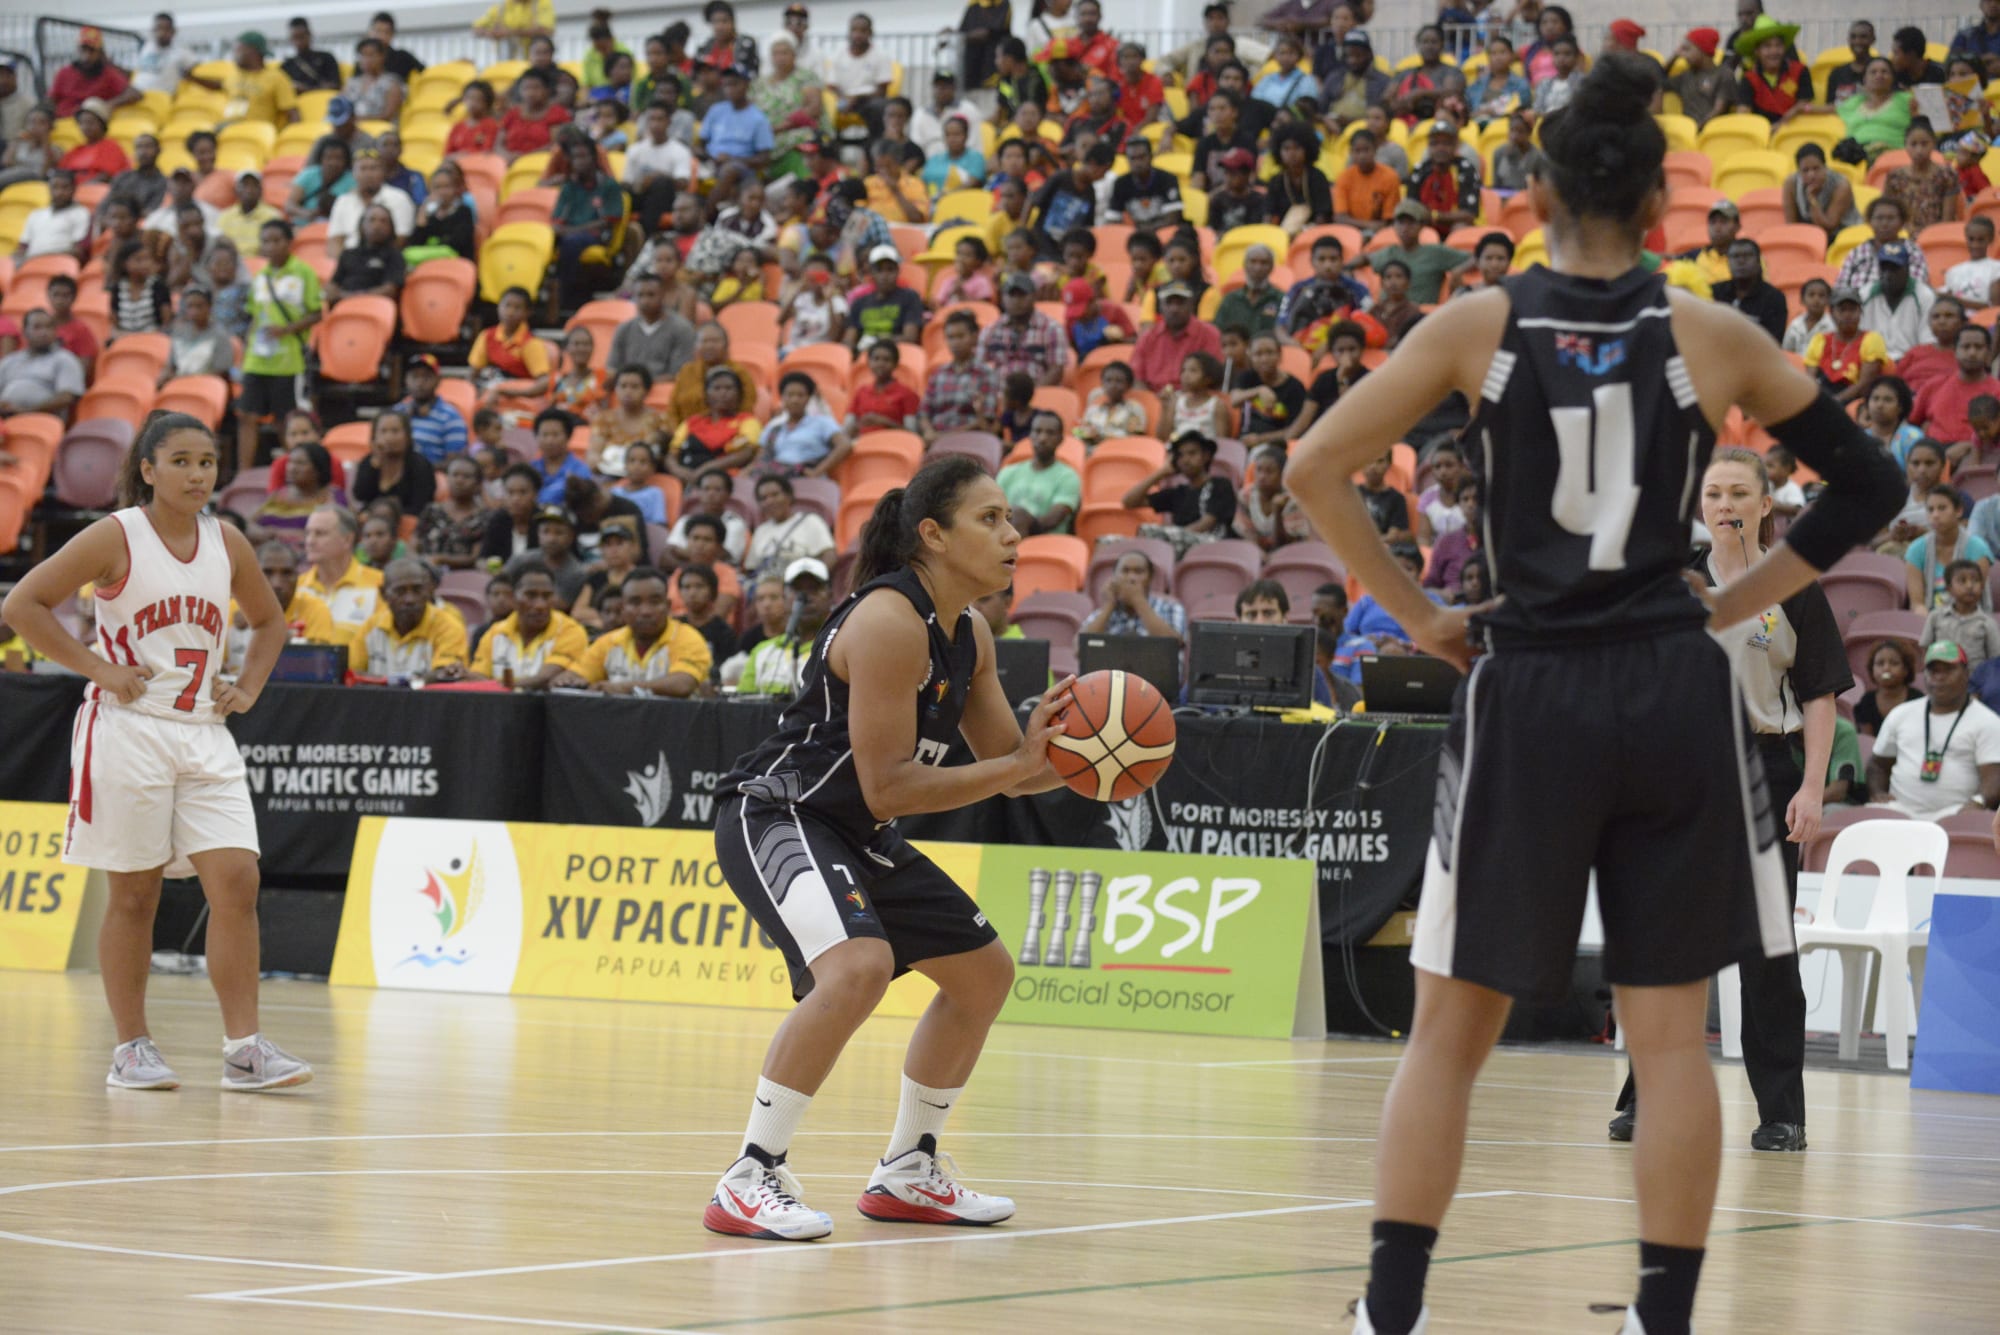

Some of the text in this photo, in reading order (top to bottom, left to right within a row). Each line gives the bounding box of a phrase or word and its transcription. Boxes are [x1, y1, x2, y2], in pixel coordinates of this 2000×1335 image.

[1549, 382, 1642, 571] 4
[134, 595, 181, 640] TEAM
[173, 648, 208, 712] 7
[240, 744, 432, 765] PORT MORESBY 2015
[272, 768, 359, 794] PACIFIC
[362, 768, 439, 796] GAMES
[691, 770, 728, 790] PO
[267, 798, 405, 813] PAPUA NEW GUINEA
[681, 793, 714, 822] XV
[1171, 802, 1383, 829] PORT MORESBY 2015
[0, 830, 63, 858] 015
[1165, 825, 1389, 862] XV PACIFIC GAMES
[565, 854, 660, 886] PORT
[832, 864, 855, 885] 7
[541, 895, 602, 941] XV
[1103, 874, 1262, 958] BSP
[596, 955, 682, 979] PAPUA
[697, 961, 757, 982] NEW
[1013, 976, 1235, 1013] Official Sponsor
